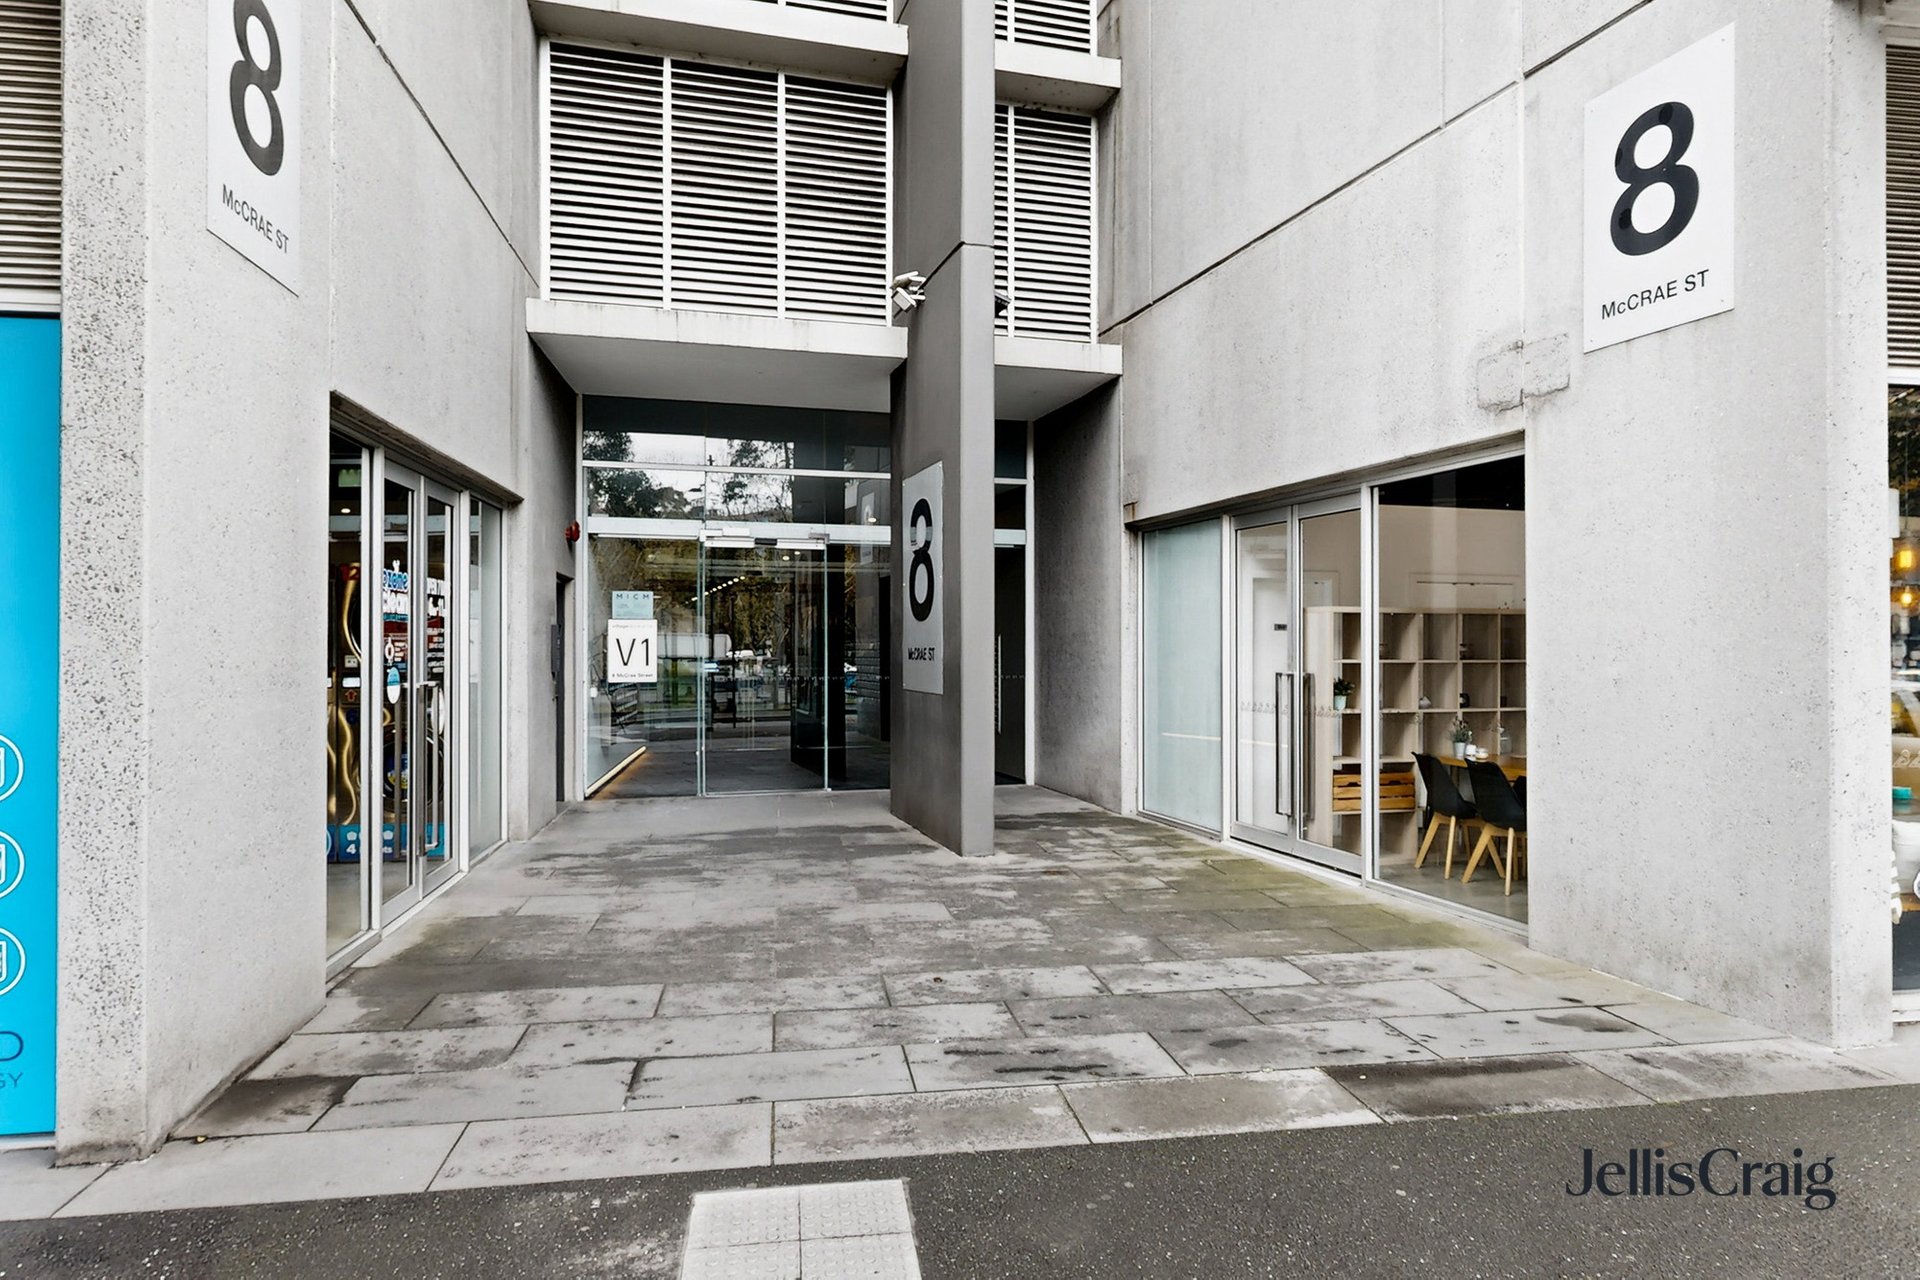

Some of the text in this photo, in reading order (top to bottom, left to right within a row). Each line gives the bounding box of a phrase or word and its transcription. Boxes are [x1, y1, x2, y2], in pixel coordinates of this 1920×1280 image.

[229, 0, 284, 176] 8
[1610, 101, 1699, 256] 8
[222, 183, 289, 254] McCRAE ST
[1601, 269, 1709, 320] McCRAE ST
[909, 498, 935, 622] 8
[616, 638, 649, 666] V1
[908, 647, 935, 661] McCRAE ST
